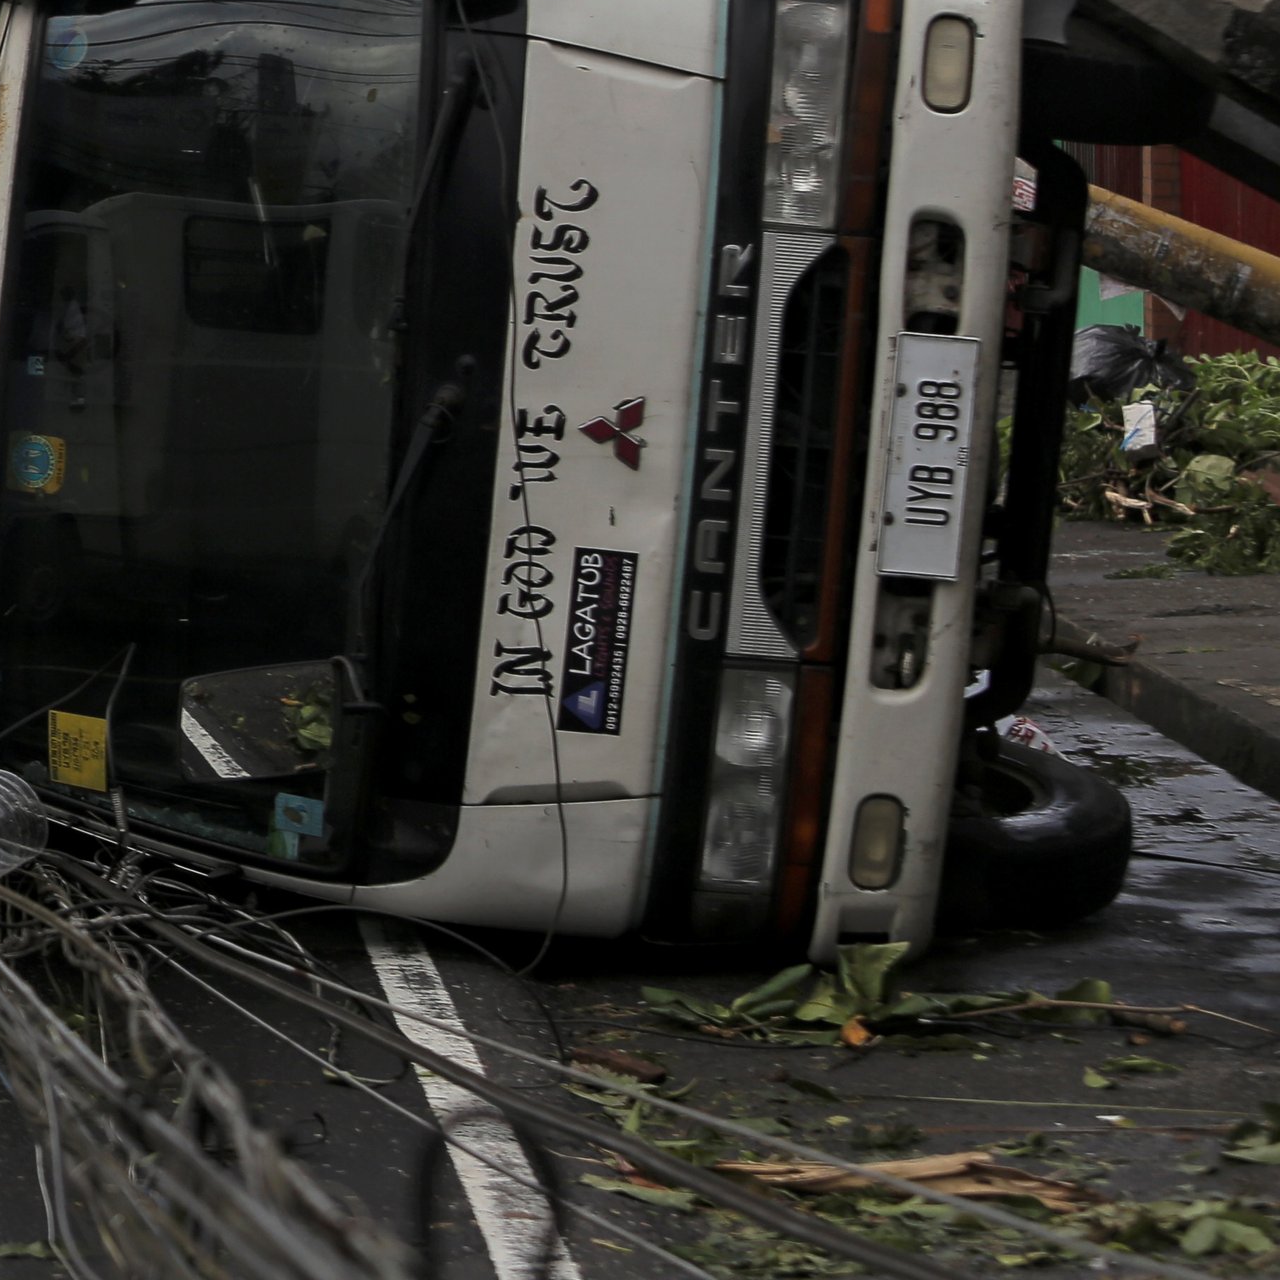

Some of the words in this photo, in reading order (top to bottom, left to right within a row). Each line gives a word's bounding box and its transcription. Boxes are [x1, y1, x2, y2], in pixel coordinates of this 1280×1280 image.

[521, 177, 599, 370] TRUST
[686, 241, 755, 642] CANTER
[912, 378, 962, 443] 988
[903, 464, 955, 528] UYB
[496, 525, 556, 620] GOD
[568, 553, 604, 676] LAGATUB
[489, 637, 555, 699] IN
